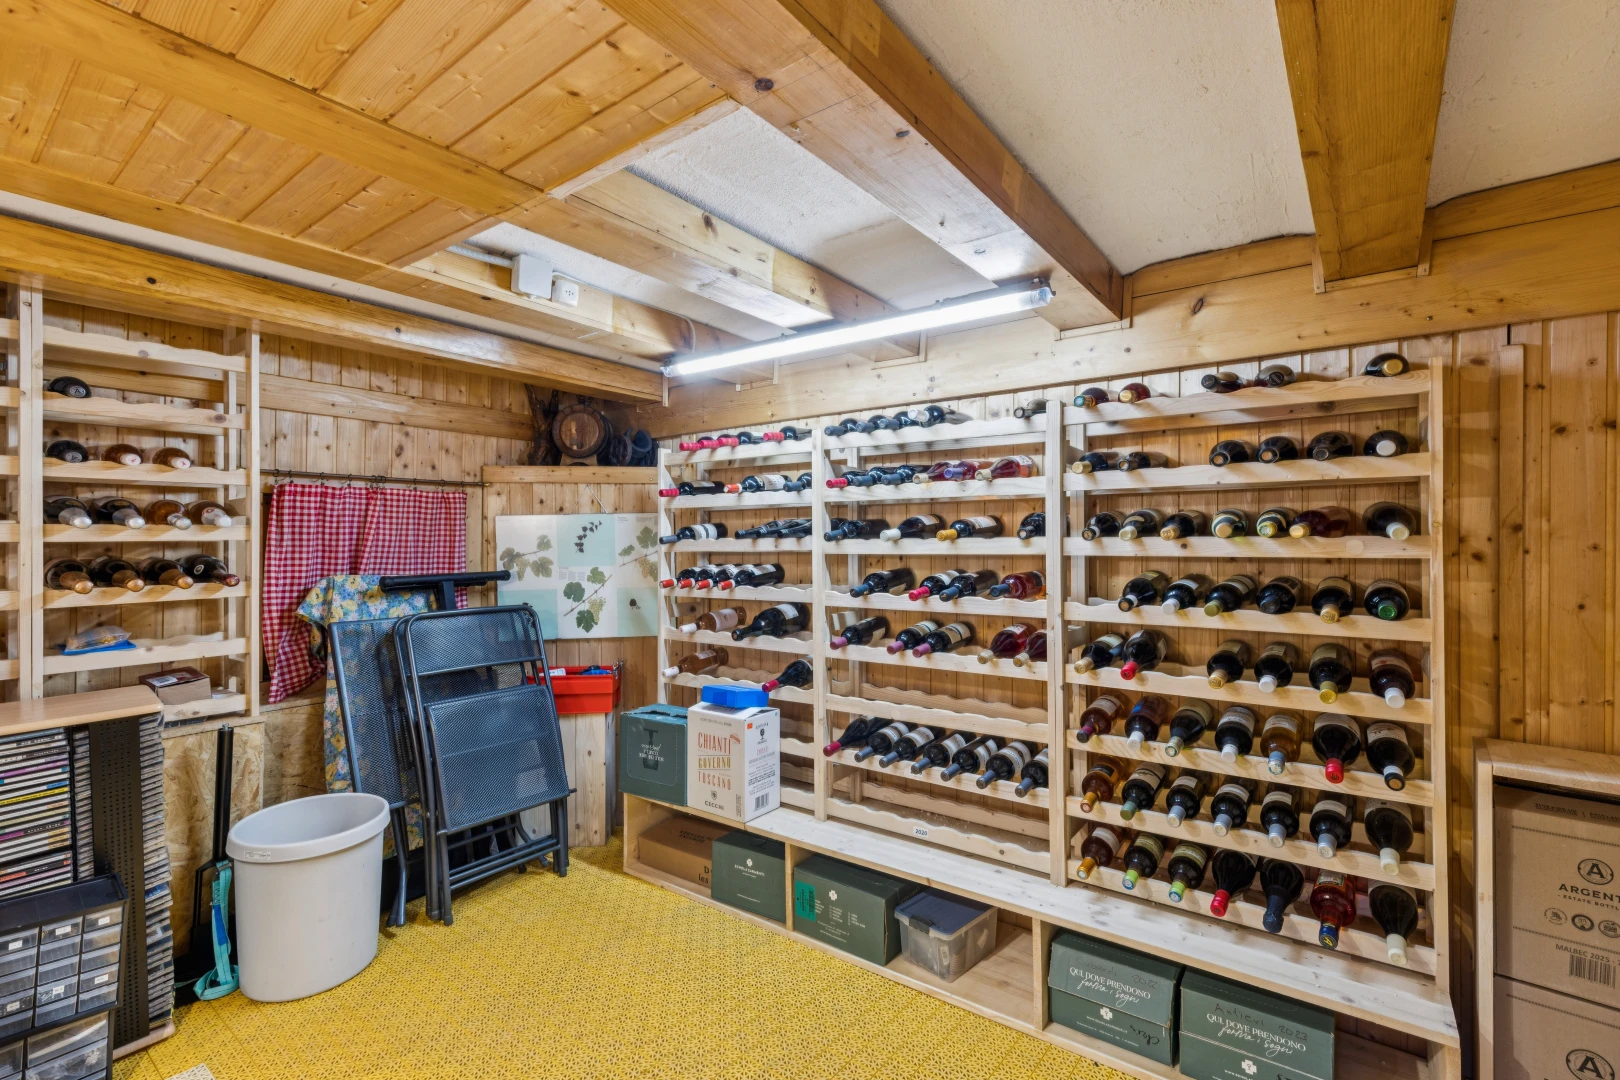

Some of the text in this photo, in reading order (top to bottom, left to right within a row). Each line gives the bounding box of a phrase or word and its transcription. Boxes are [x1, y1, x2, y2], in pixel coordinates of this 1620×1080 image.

[698, 732, 730, 754] CHIANTI
[698, 757, 730, 768] GOVERNO
[698, 771, 731, 790] TOSCANO
[698, 873, 708, 884] les
[1586, 862, 1607, 879] A
[1563, 895, 1592, 904] ESTATE
[1555, 944, 1588, 958] MALBEC
[1590, 952, 1610, 963] 2025
[1077, 978, 1108, 992] forma
[1086, 970, 1106, 984] DOVE
[1106, 980, 1150, 1000] PRENDONO
[1132, 974, 1158, 990] 2022
[1218, 1025, 1255, 1041] forma
[1226, 1019, 1250, 1033] DOVE
[1252, 1028, 1306, 1052] PRENDONO
[1278, 1026, 1308, 1041] 2023
[1576, 1054, 1604, 1080] A
